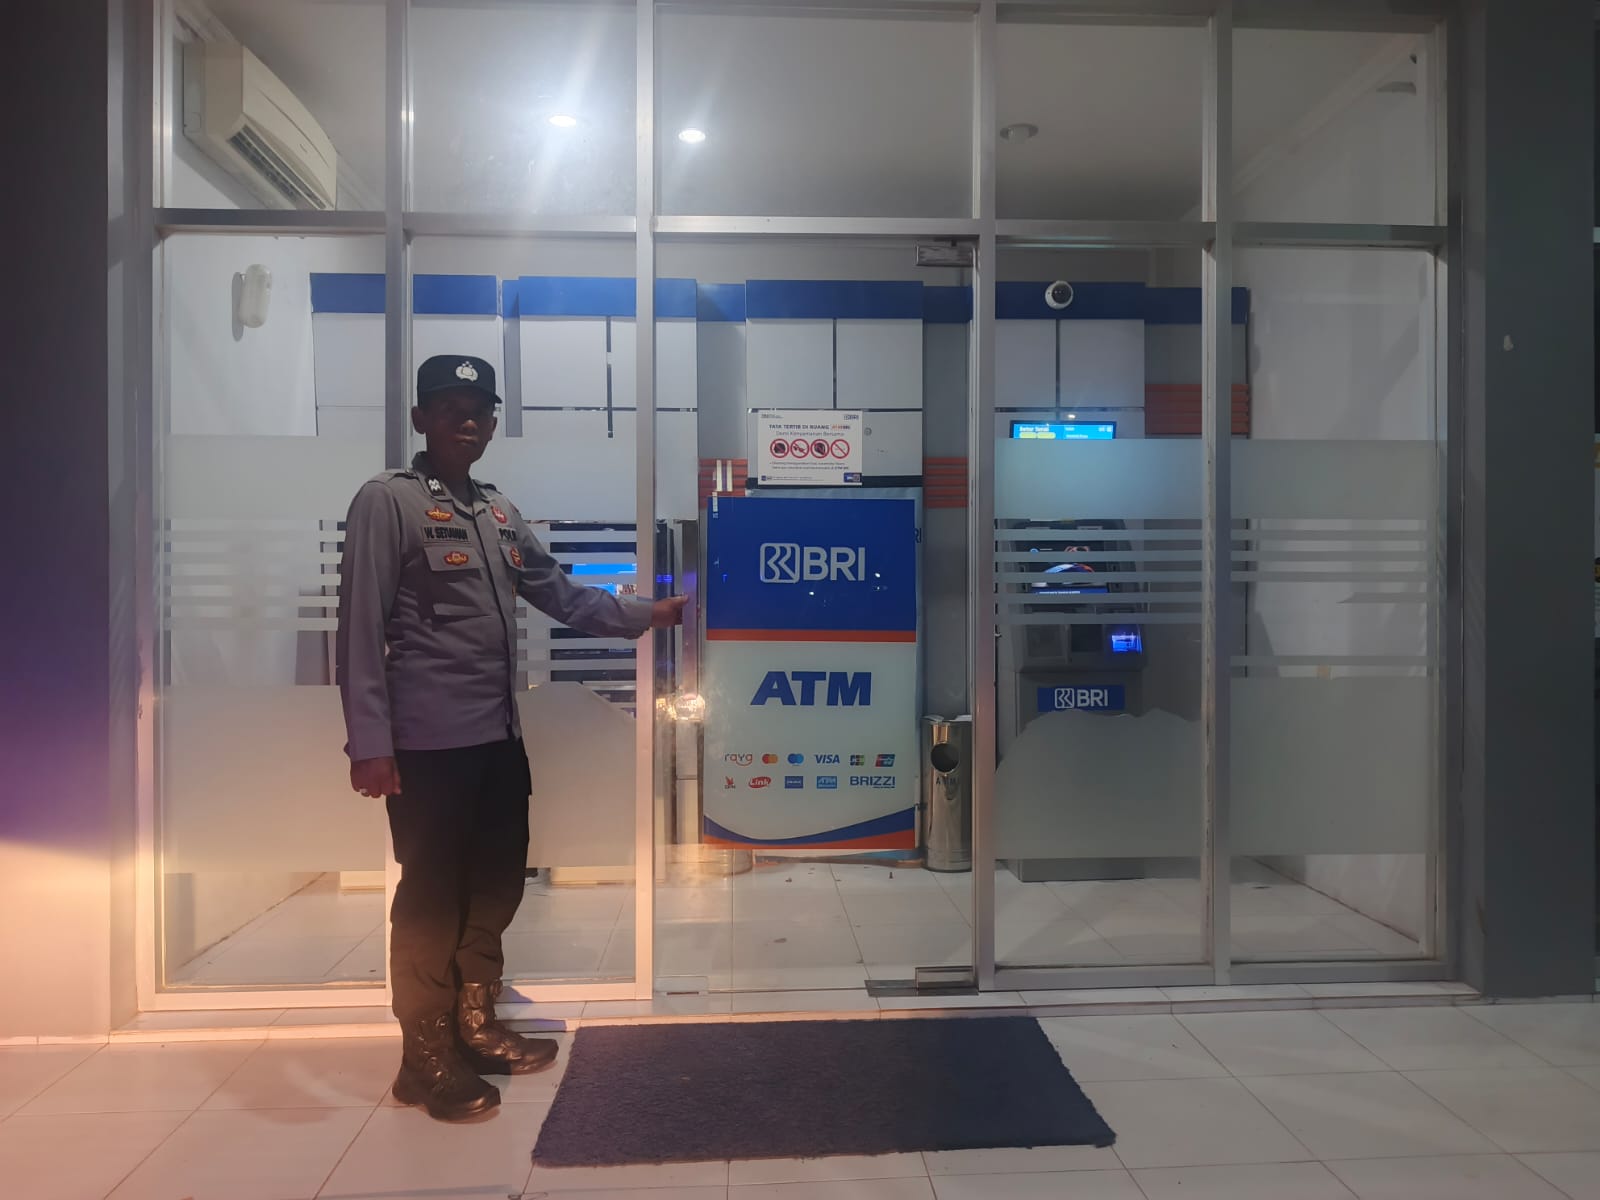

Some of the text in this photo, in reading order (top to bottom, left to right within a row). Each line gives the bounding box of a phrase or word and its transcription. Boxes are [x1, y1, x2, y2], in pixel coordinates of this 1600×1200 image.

[803, 546, 866, 582] BRI
[750, 671, 872, 706] ATM
[1077, 689, 1108, 707] BRI
[814, 754, 840, 764] VISA
[849, 776, 896, 786] BRIZZI
